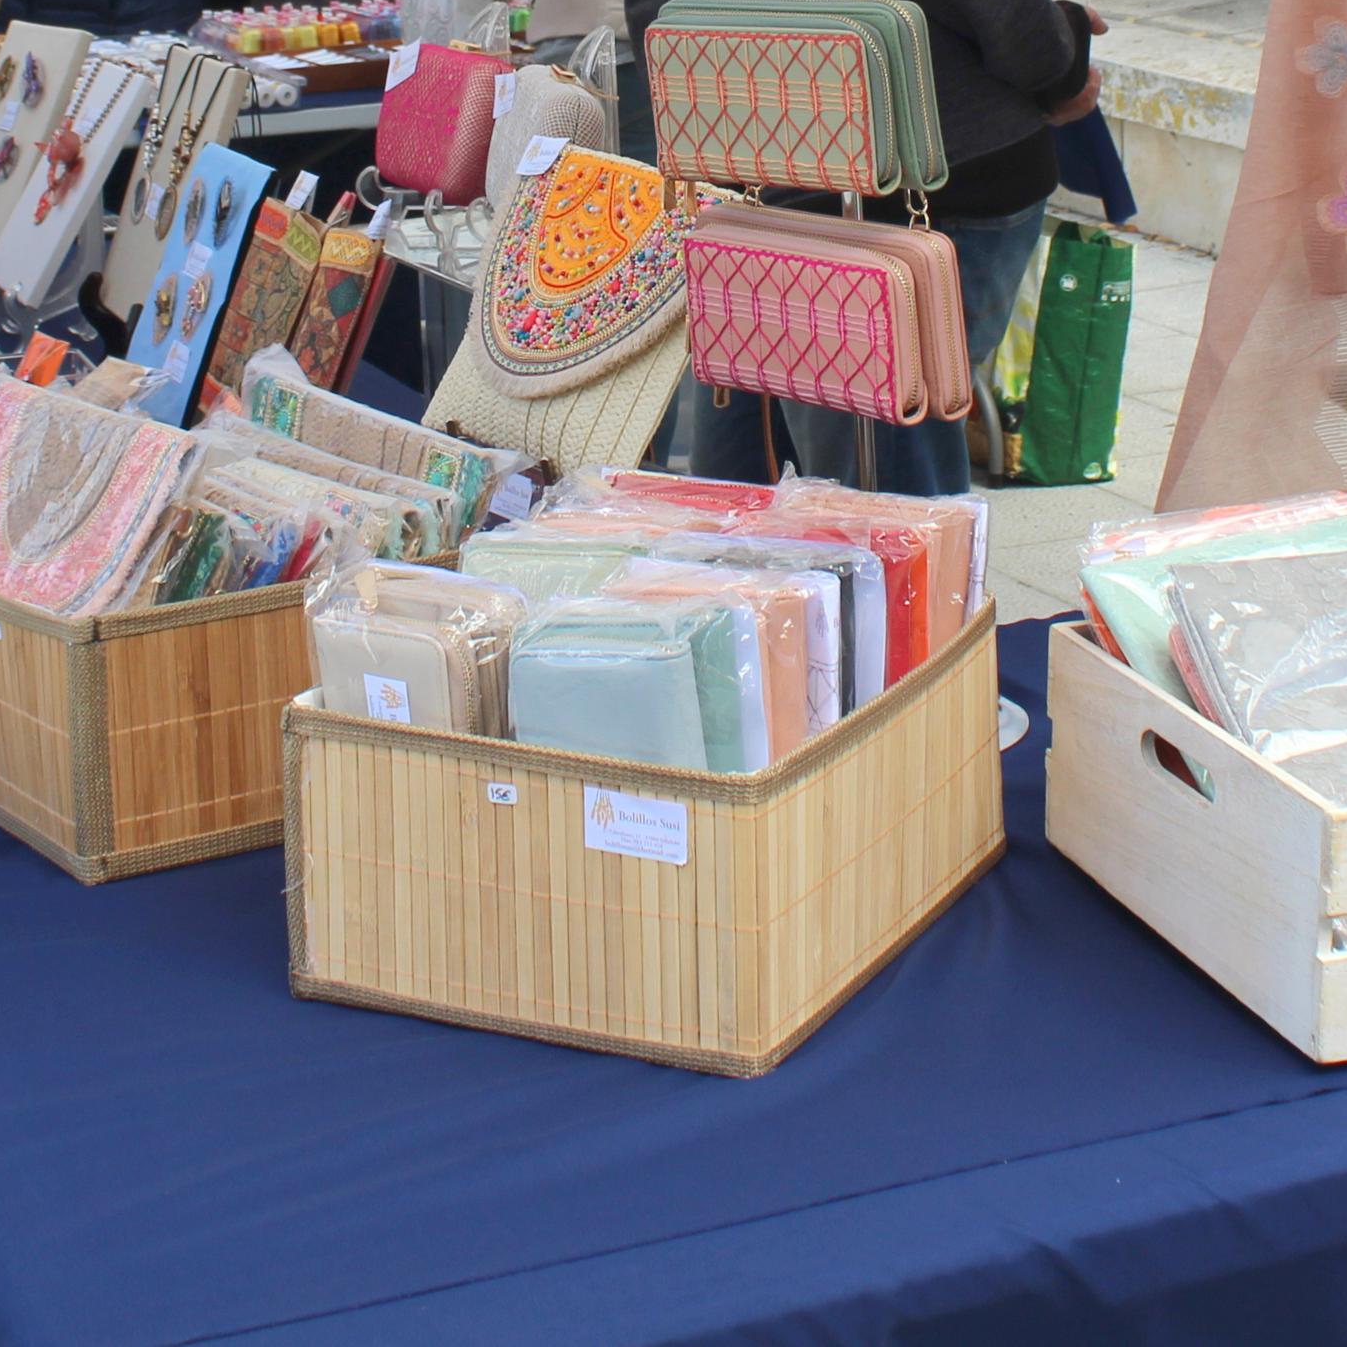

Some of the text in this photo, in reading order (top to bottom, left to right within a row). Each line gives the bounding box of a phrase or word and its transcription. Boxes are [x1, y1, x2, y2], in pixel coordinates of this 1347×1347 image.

[490, 787, 512, 802] 15€
[618, 810, 680, 831] Bolillos Susi
